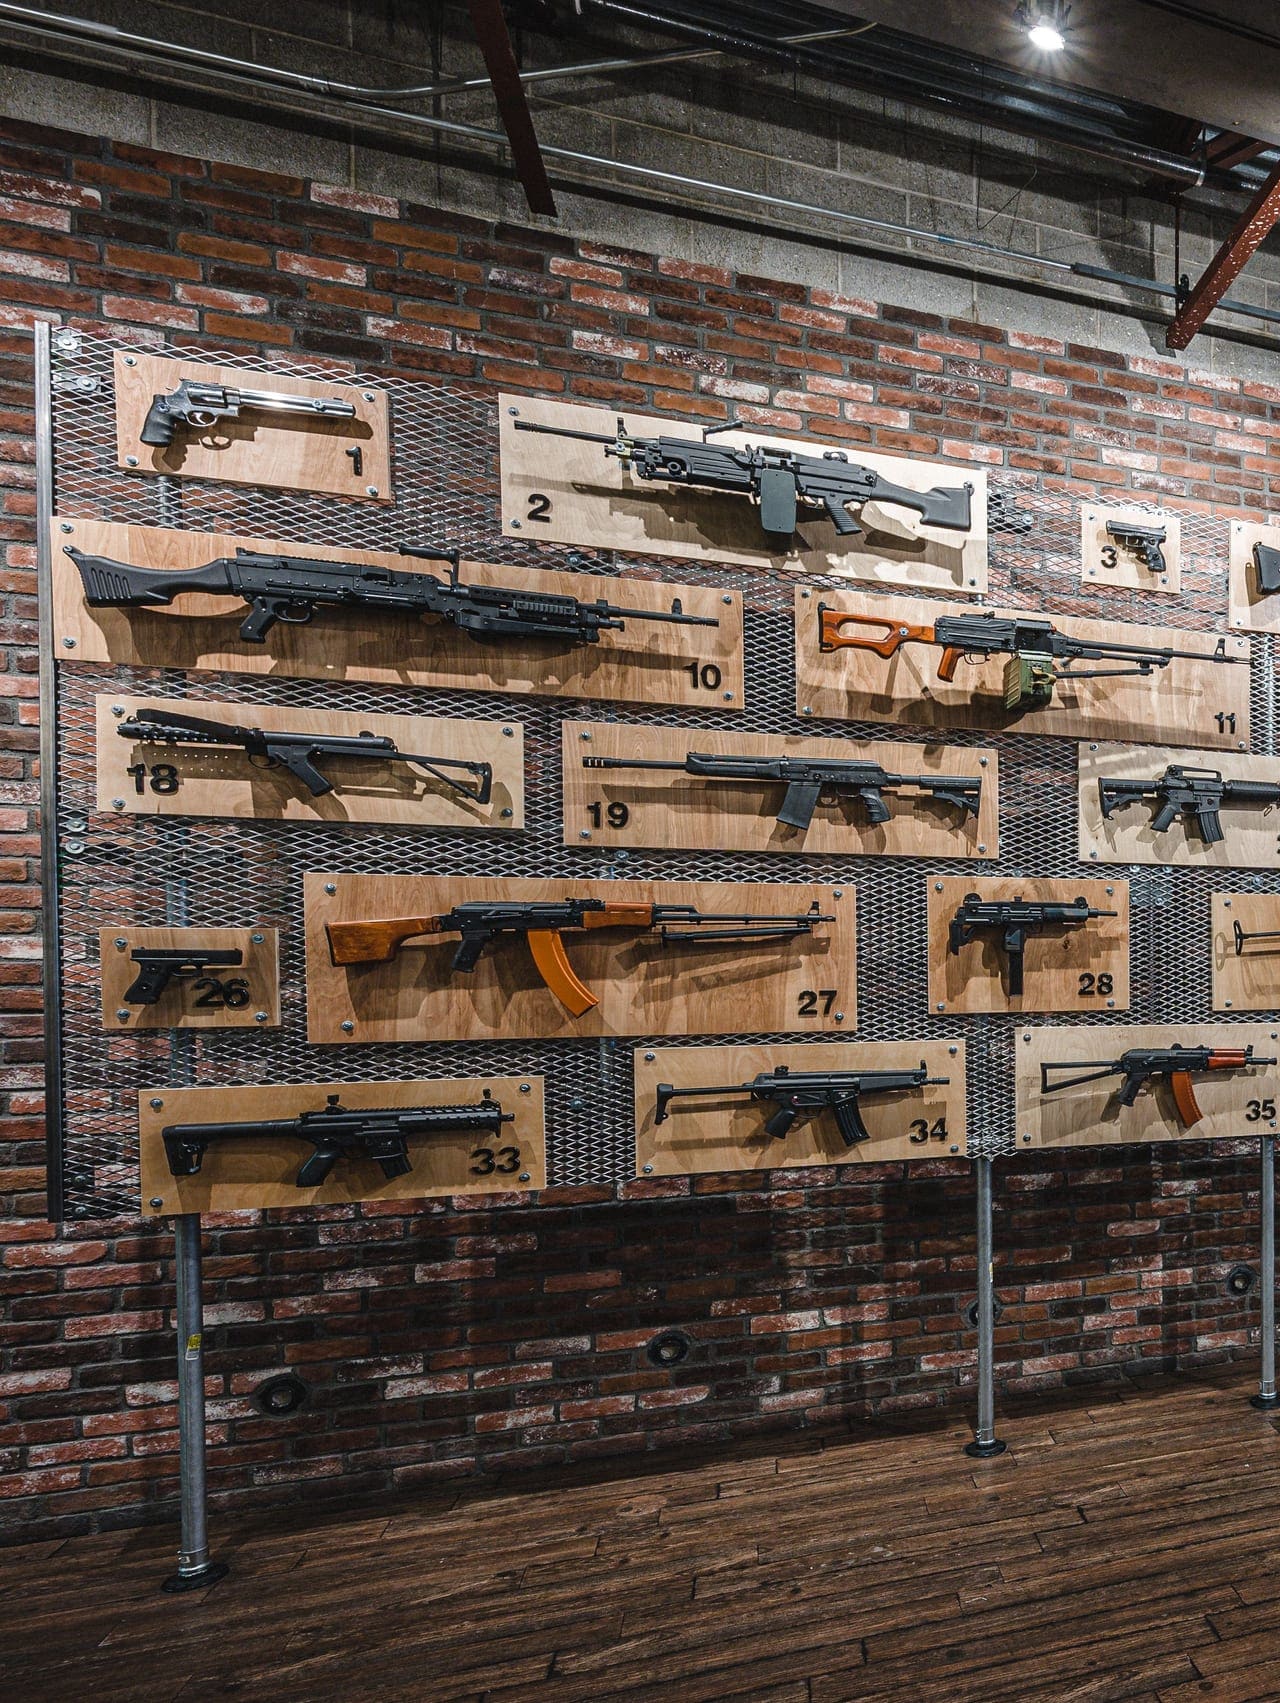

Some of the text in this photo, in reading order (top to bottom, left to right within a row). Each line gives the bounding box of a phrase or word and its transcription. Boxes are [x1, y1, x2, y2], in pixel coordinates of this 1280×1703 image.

[346, 445, 363, 477] 1
[528, 493, 551, 523] 2
[1100, 545, 1118, 569] 3
[682, 661, 723, 690] 10
[1214, 711, 1236, 734] 11
[126, 763, 180, 797] 18
[587, 800, 630, 830] 19
[193, 977, 250, 1009] 26
[1077, 972, 1114, 997] 28
[798, 988, 838, 1017] 27
[1244, 1099, 1277, 1122] 35
[909, 1118, 949, 1144] 34
[470, 1147, 522, 1176] 33
